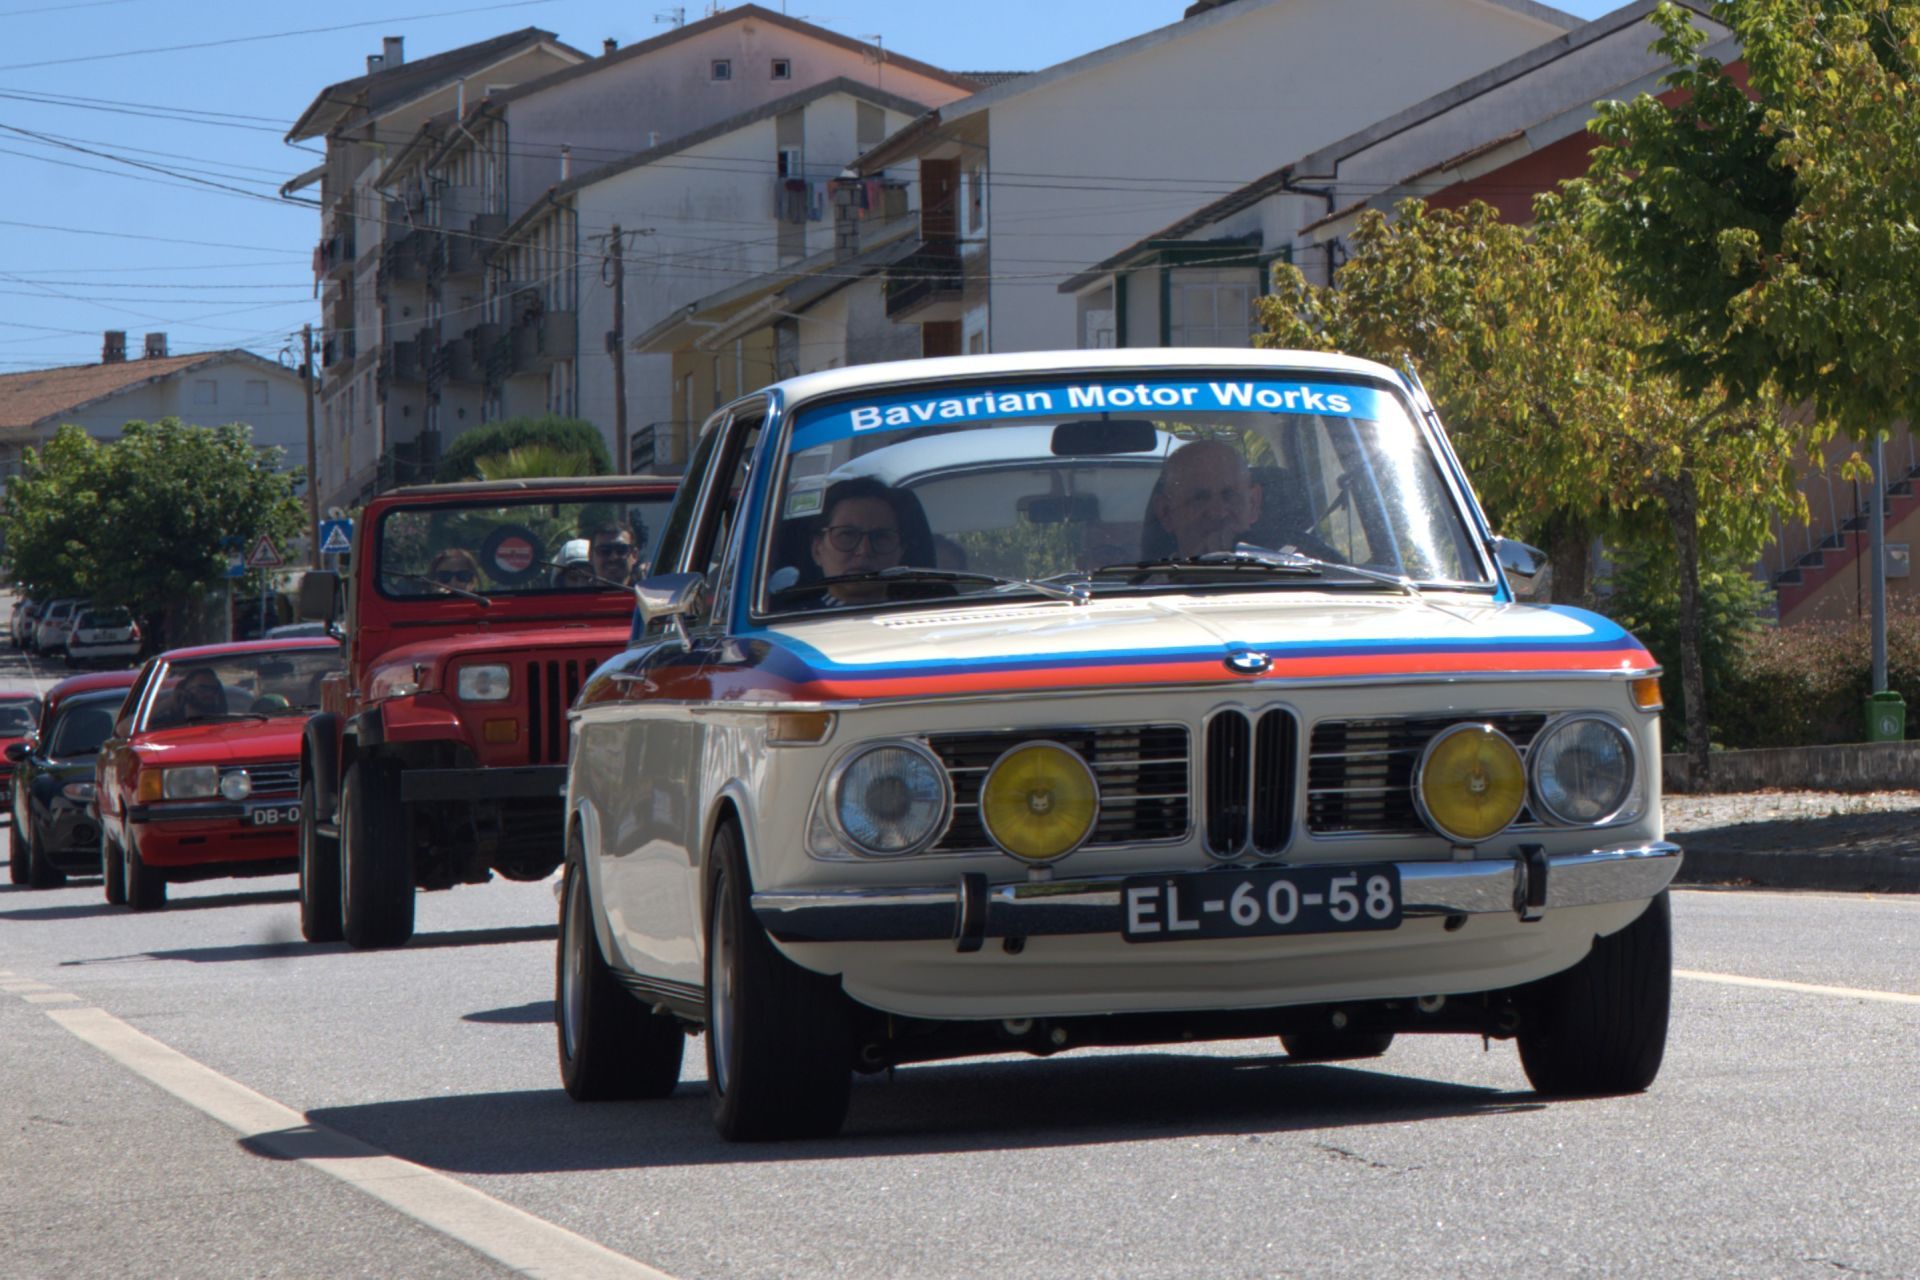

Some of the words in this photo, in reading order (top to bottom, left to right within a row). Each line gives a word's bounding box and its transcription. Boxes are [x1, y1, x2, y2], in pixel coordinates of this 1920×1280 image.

[850, 391, 1053, 431] Bavarian
[1067, 384, 1198, 408] Motor
[1209, 382, 1352, 413] Works
[1127, 874, 1394, 934] EL-60-58
